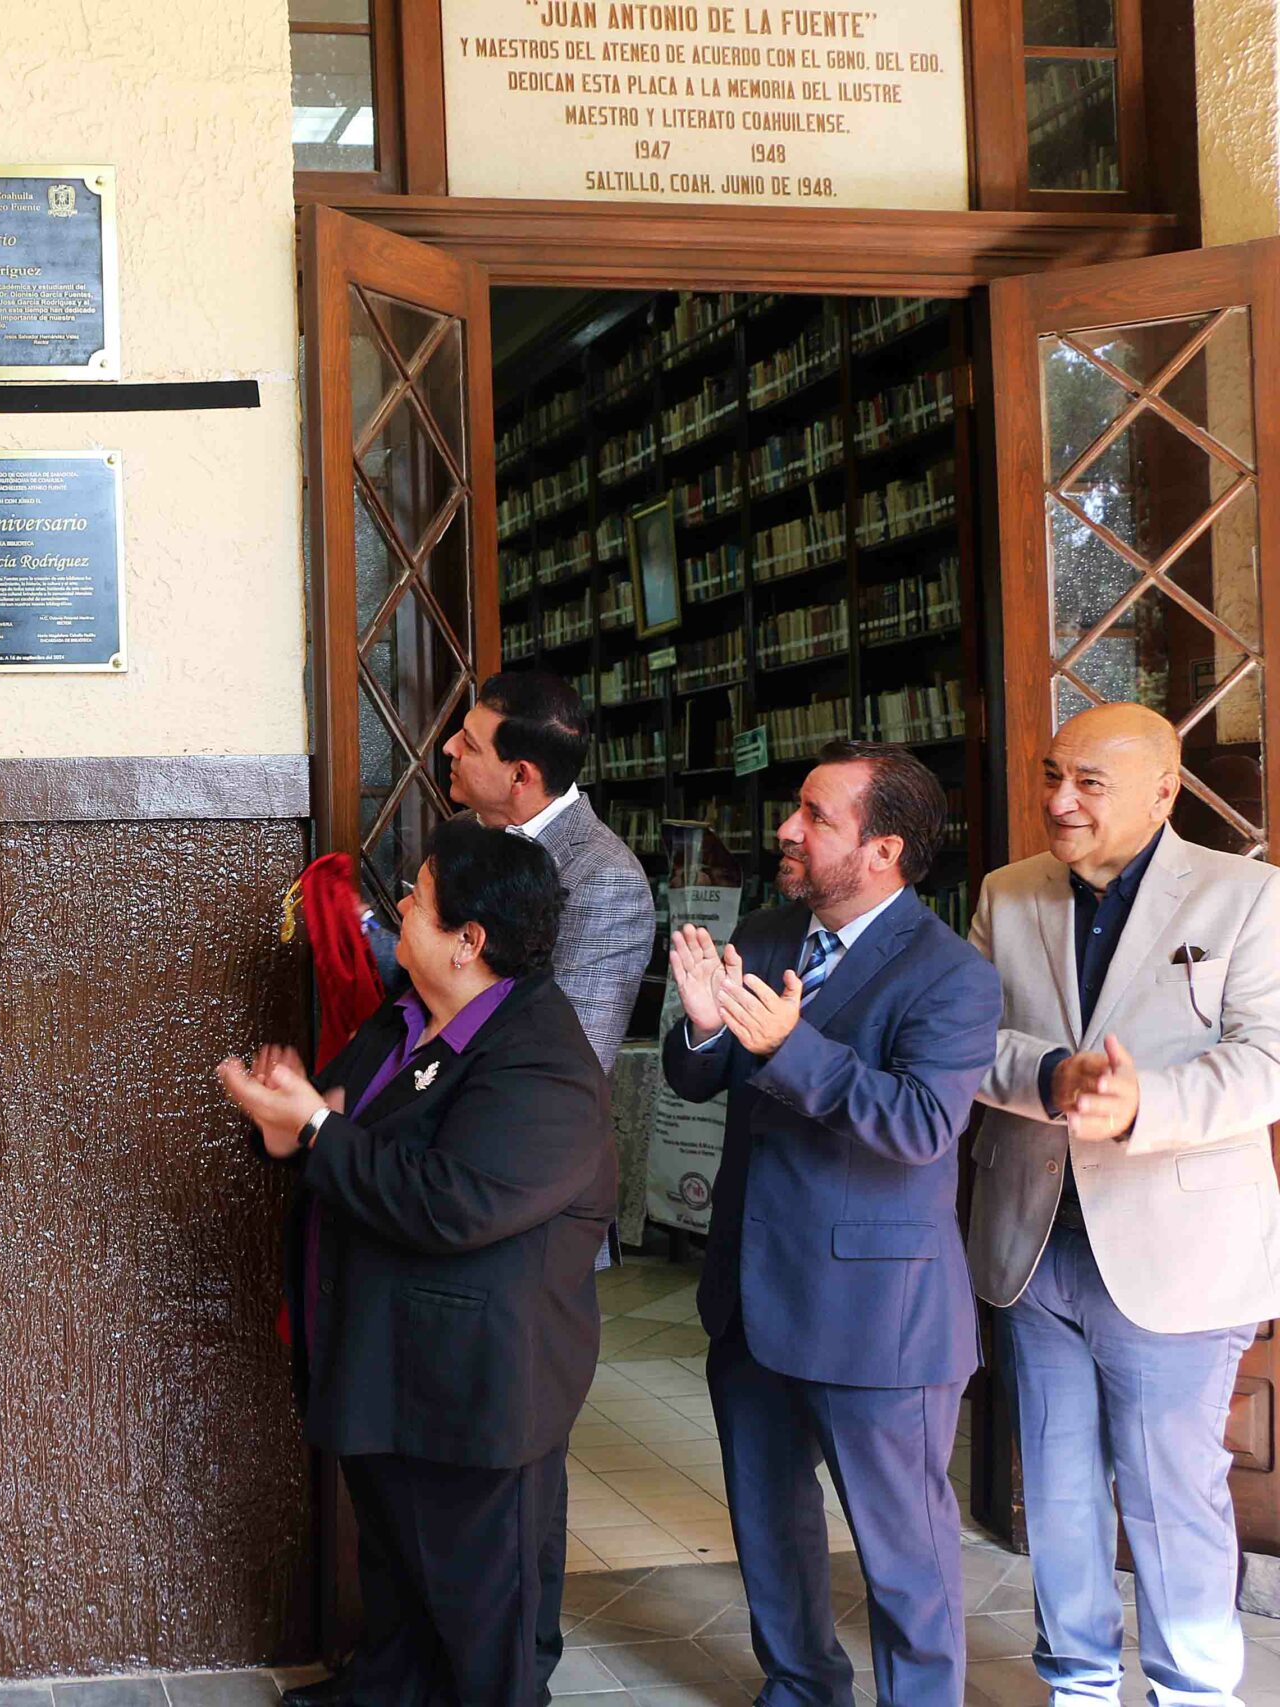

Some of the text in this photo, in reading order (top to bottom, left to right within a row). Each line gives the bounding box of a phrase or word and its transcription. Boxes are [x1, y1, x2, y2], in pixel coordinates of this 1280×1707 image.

[608, 3, 698, 32] ANTONIO
[708, 6, 734, 34] DE
[745, 8, 771, 35] LA
[460, 38, 945, 74] Y MAESTROS DEL ATENEO DE ACUERDO CON EL GBNO. DEL EDO.
[508, 72, 903, 104] DEDICAN ESTA PLACA A LA MEMORIA DEL ILUSTRE
[565, 105, 851, 134] MAESTRO Y LITERATO COAHUILENSE.
[634, 140, 671, 161] 1947
[751, 143, 787, 165] 1948
[586, 171, 838, 198] SALTILLO, COAH. JUNIO DE 1948.
[12, 203, 41, 211] Fuente
[20, 553, 89, 571] Rodríguez
